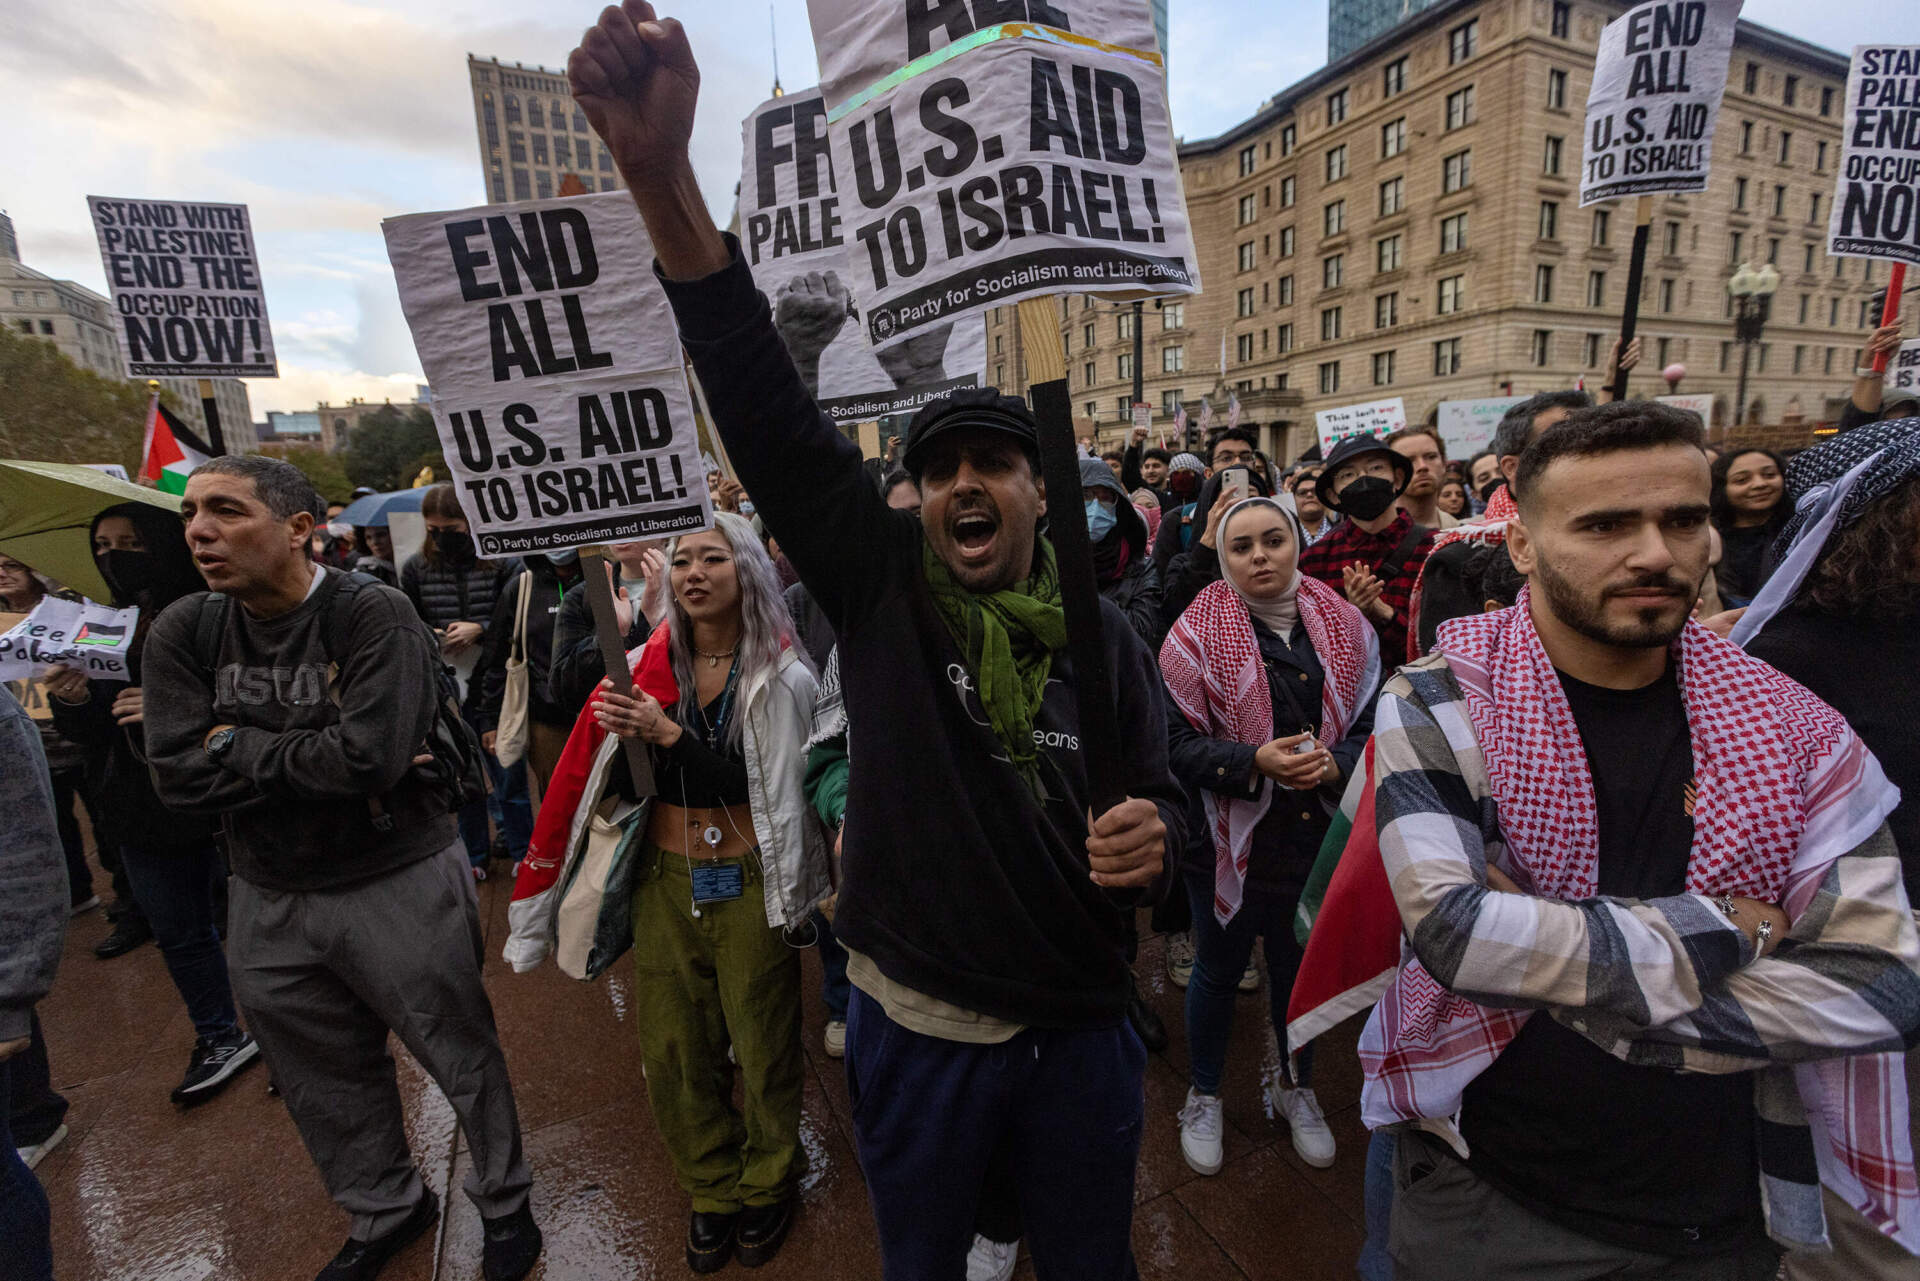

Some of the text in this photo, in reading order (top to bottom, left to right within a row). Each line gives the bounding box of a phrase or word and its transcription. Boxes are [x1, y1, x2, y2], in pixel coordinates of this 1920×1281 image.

[1625, 1, 1706, 56] END
[1625, 50, 1691, 100] ALL
[849, 57, 1147, 210] U.S. AID
[1592, 103, 1708, 153] U.S. AID
[1588, 144, 1703, 183] TO ISRAEL!
[98, 202, 244, 231] STAND WITH
[856, 165, 1166, 291] TO ISRAEL!
[1839, 181, 1920, 241] NO
[104, 228, 249, 255] PALESTINE!
[444, 208, 600, 302] END
[110, 255, 258, 291] END THE
[900, 301, 942, 325] Party
[946, 286, 971, 308] for
[976, 264, 1068, 295] Socialism
[1073, 260, 1104, 278] and
[1109, 261, 1188, 281] Liberation
[118, 294, 259, 317] OCCUPATION
[123, 316, 266, 363] NOW!
[487, 294, 614, 382] ALL
[449, 388, 674, 473] U.S. AID
[831, 402, 890, 417] Socialism
[893, 396, 914, 409] and
[465, 454, 688, 524] TO ISRAEL!
[502, 537, 532, 550] Party
[534, 535, 550, 546] for
[553, 527, 612, 544] Socialism
[616, 522, 639, 536] and
[641, 515, 702, 532] Liberation
